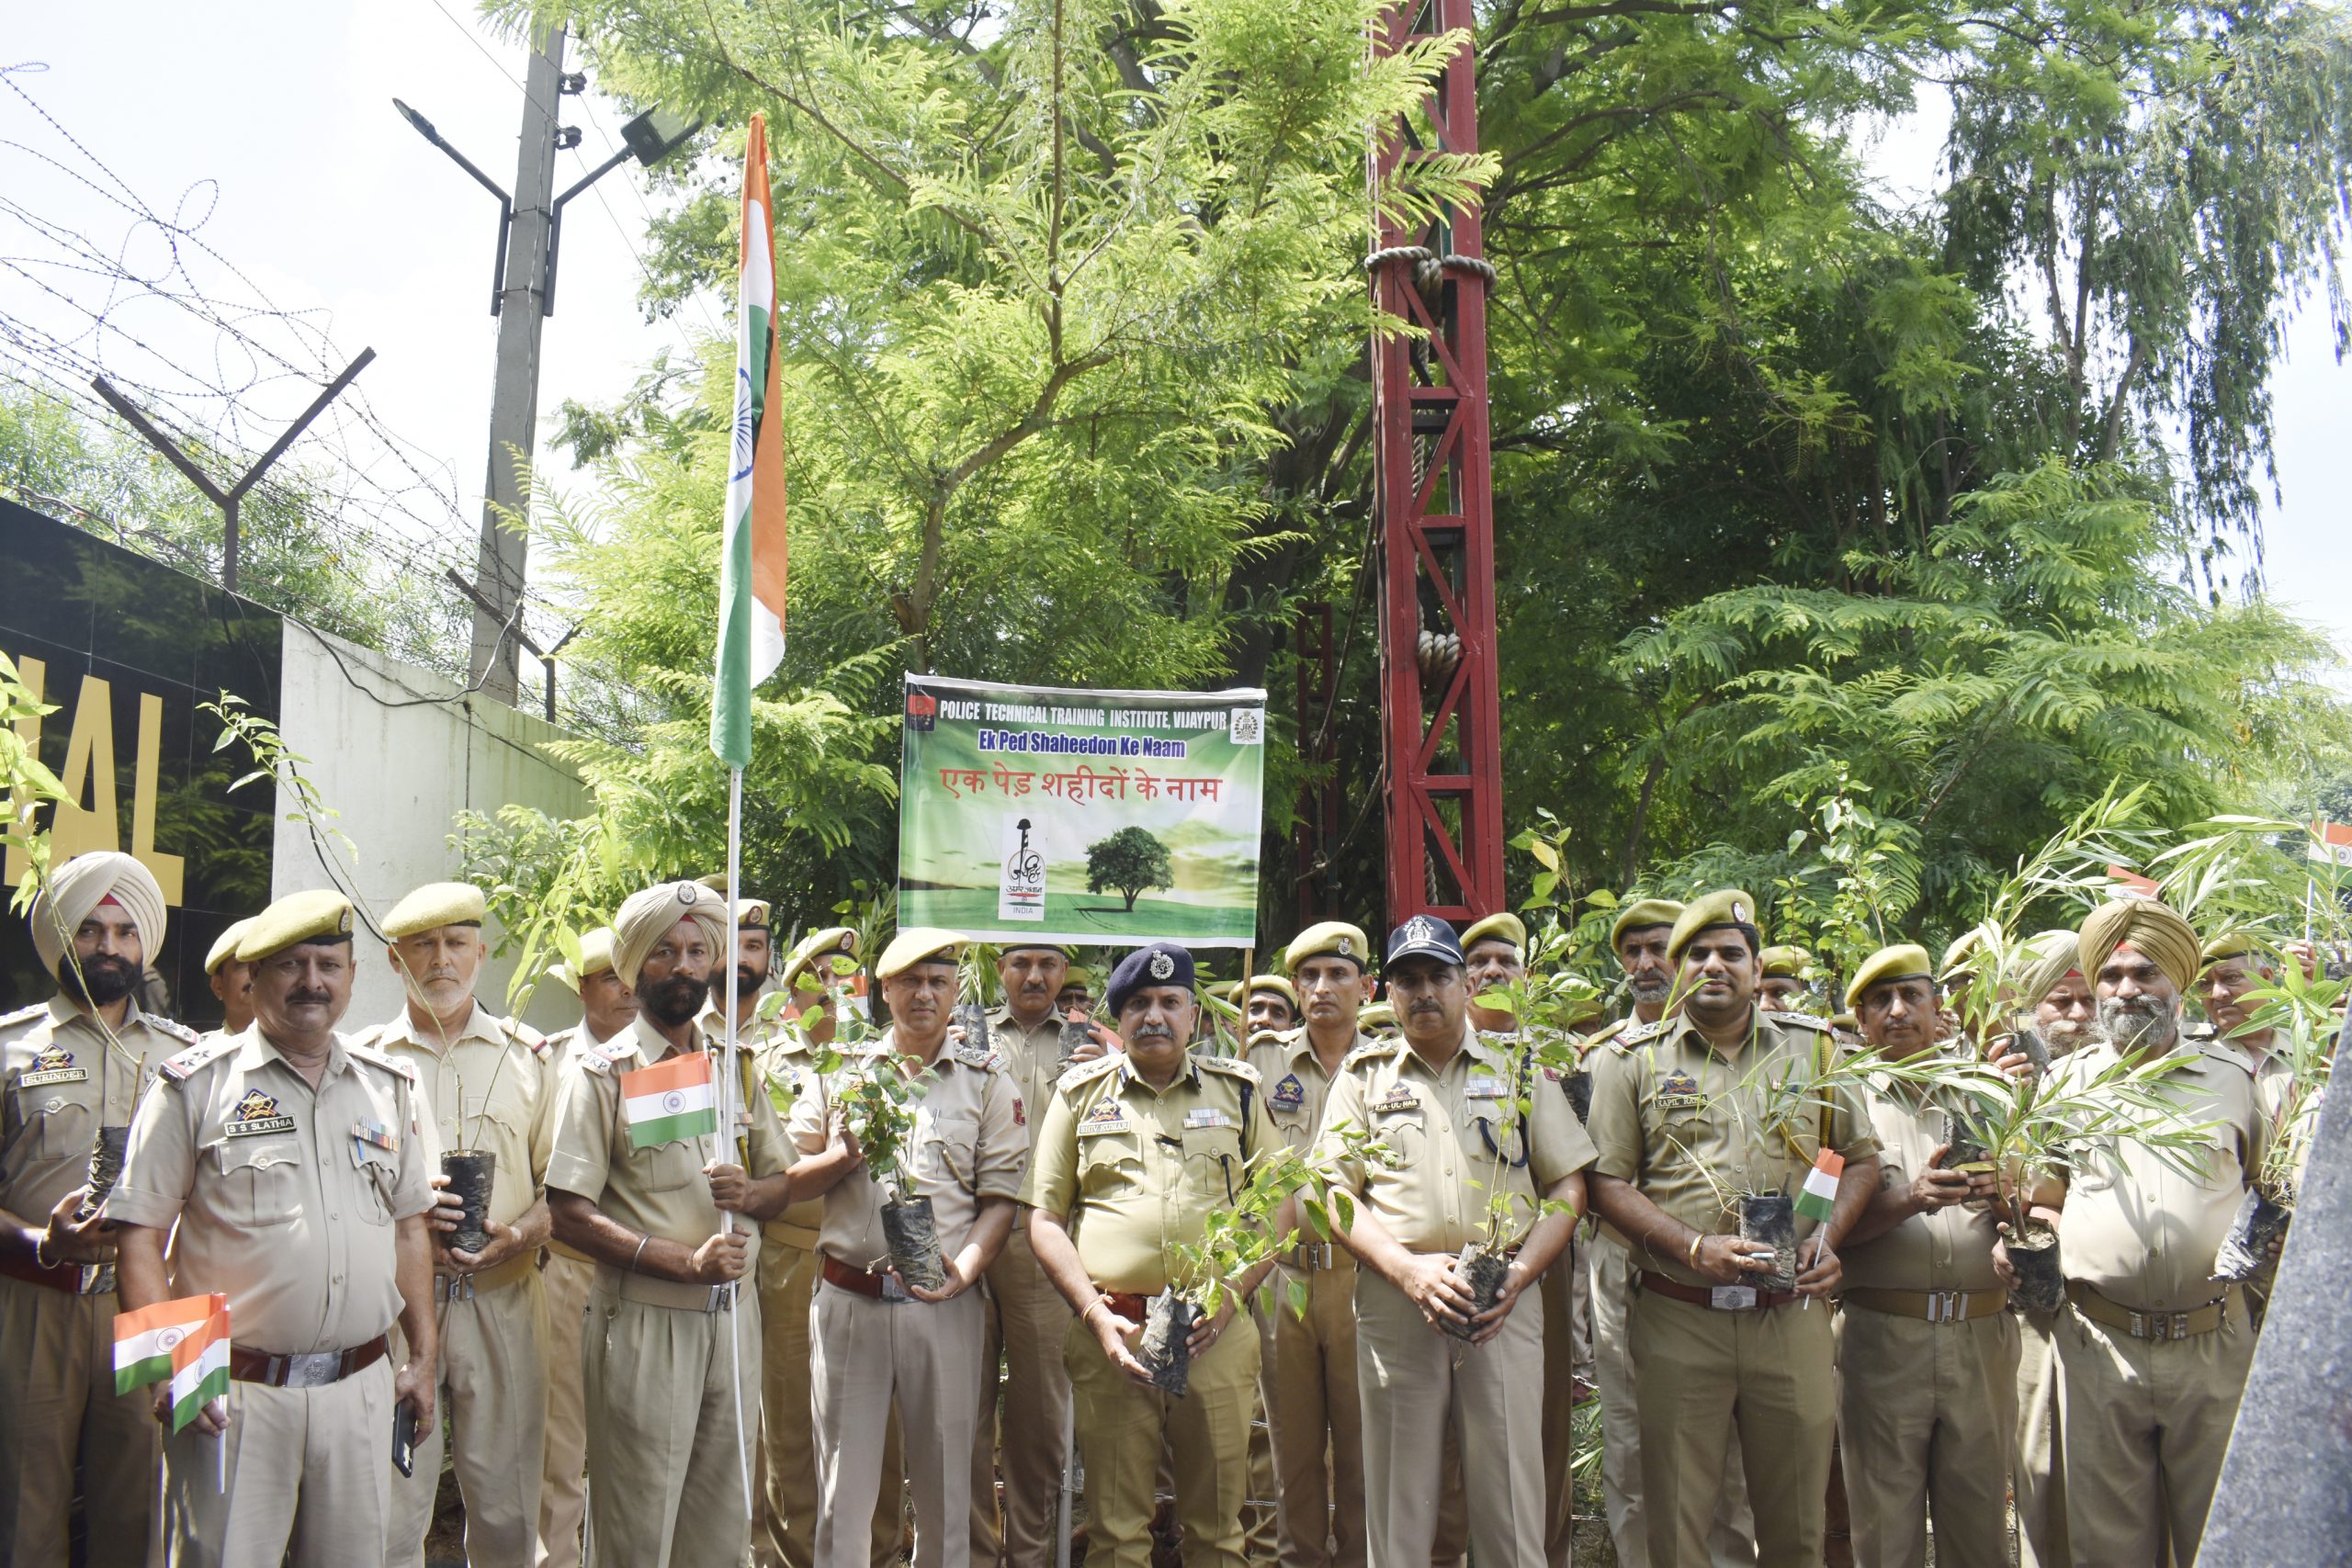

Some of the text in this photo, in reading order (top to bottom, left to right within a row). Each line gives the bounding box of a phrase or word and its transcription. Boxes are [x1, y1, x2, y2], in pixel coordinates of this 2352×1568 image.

[940, 700, 1227, 730] POLICE TECHNICAL TRAINING INSTITUTE, VIJAYPUR
[978, 730, 1185, 758] Ek Ped Shaheedon Ke Naam
[939, 761, 1224, 806] एक पेड़ शहीदों के नाम
[1012, 906, 1034, 914] INDIA
[26, 1070, 85, 1084] SURINDER
[240, 1123, 247, 1132] S
[251, 1118, 292, 1131] SLATHIA
